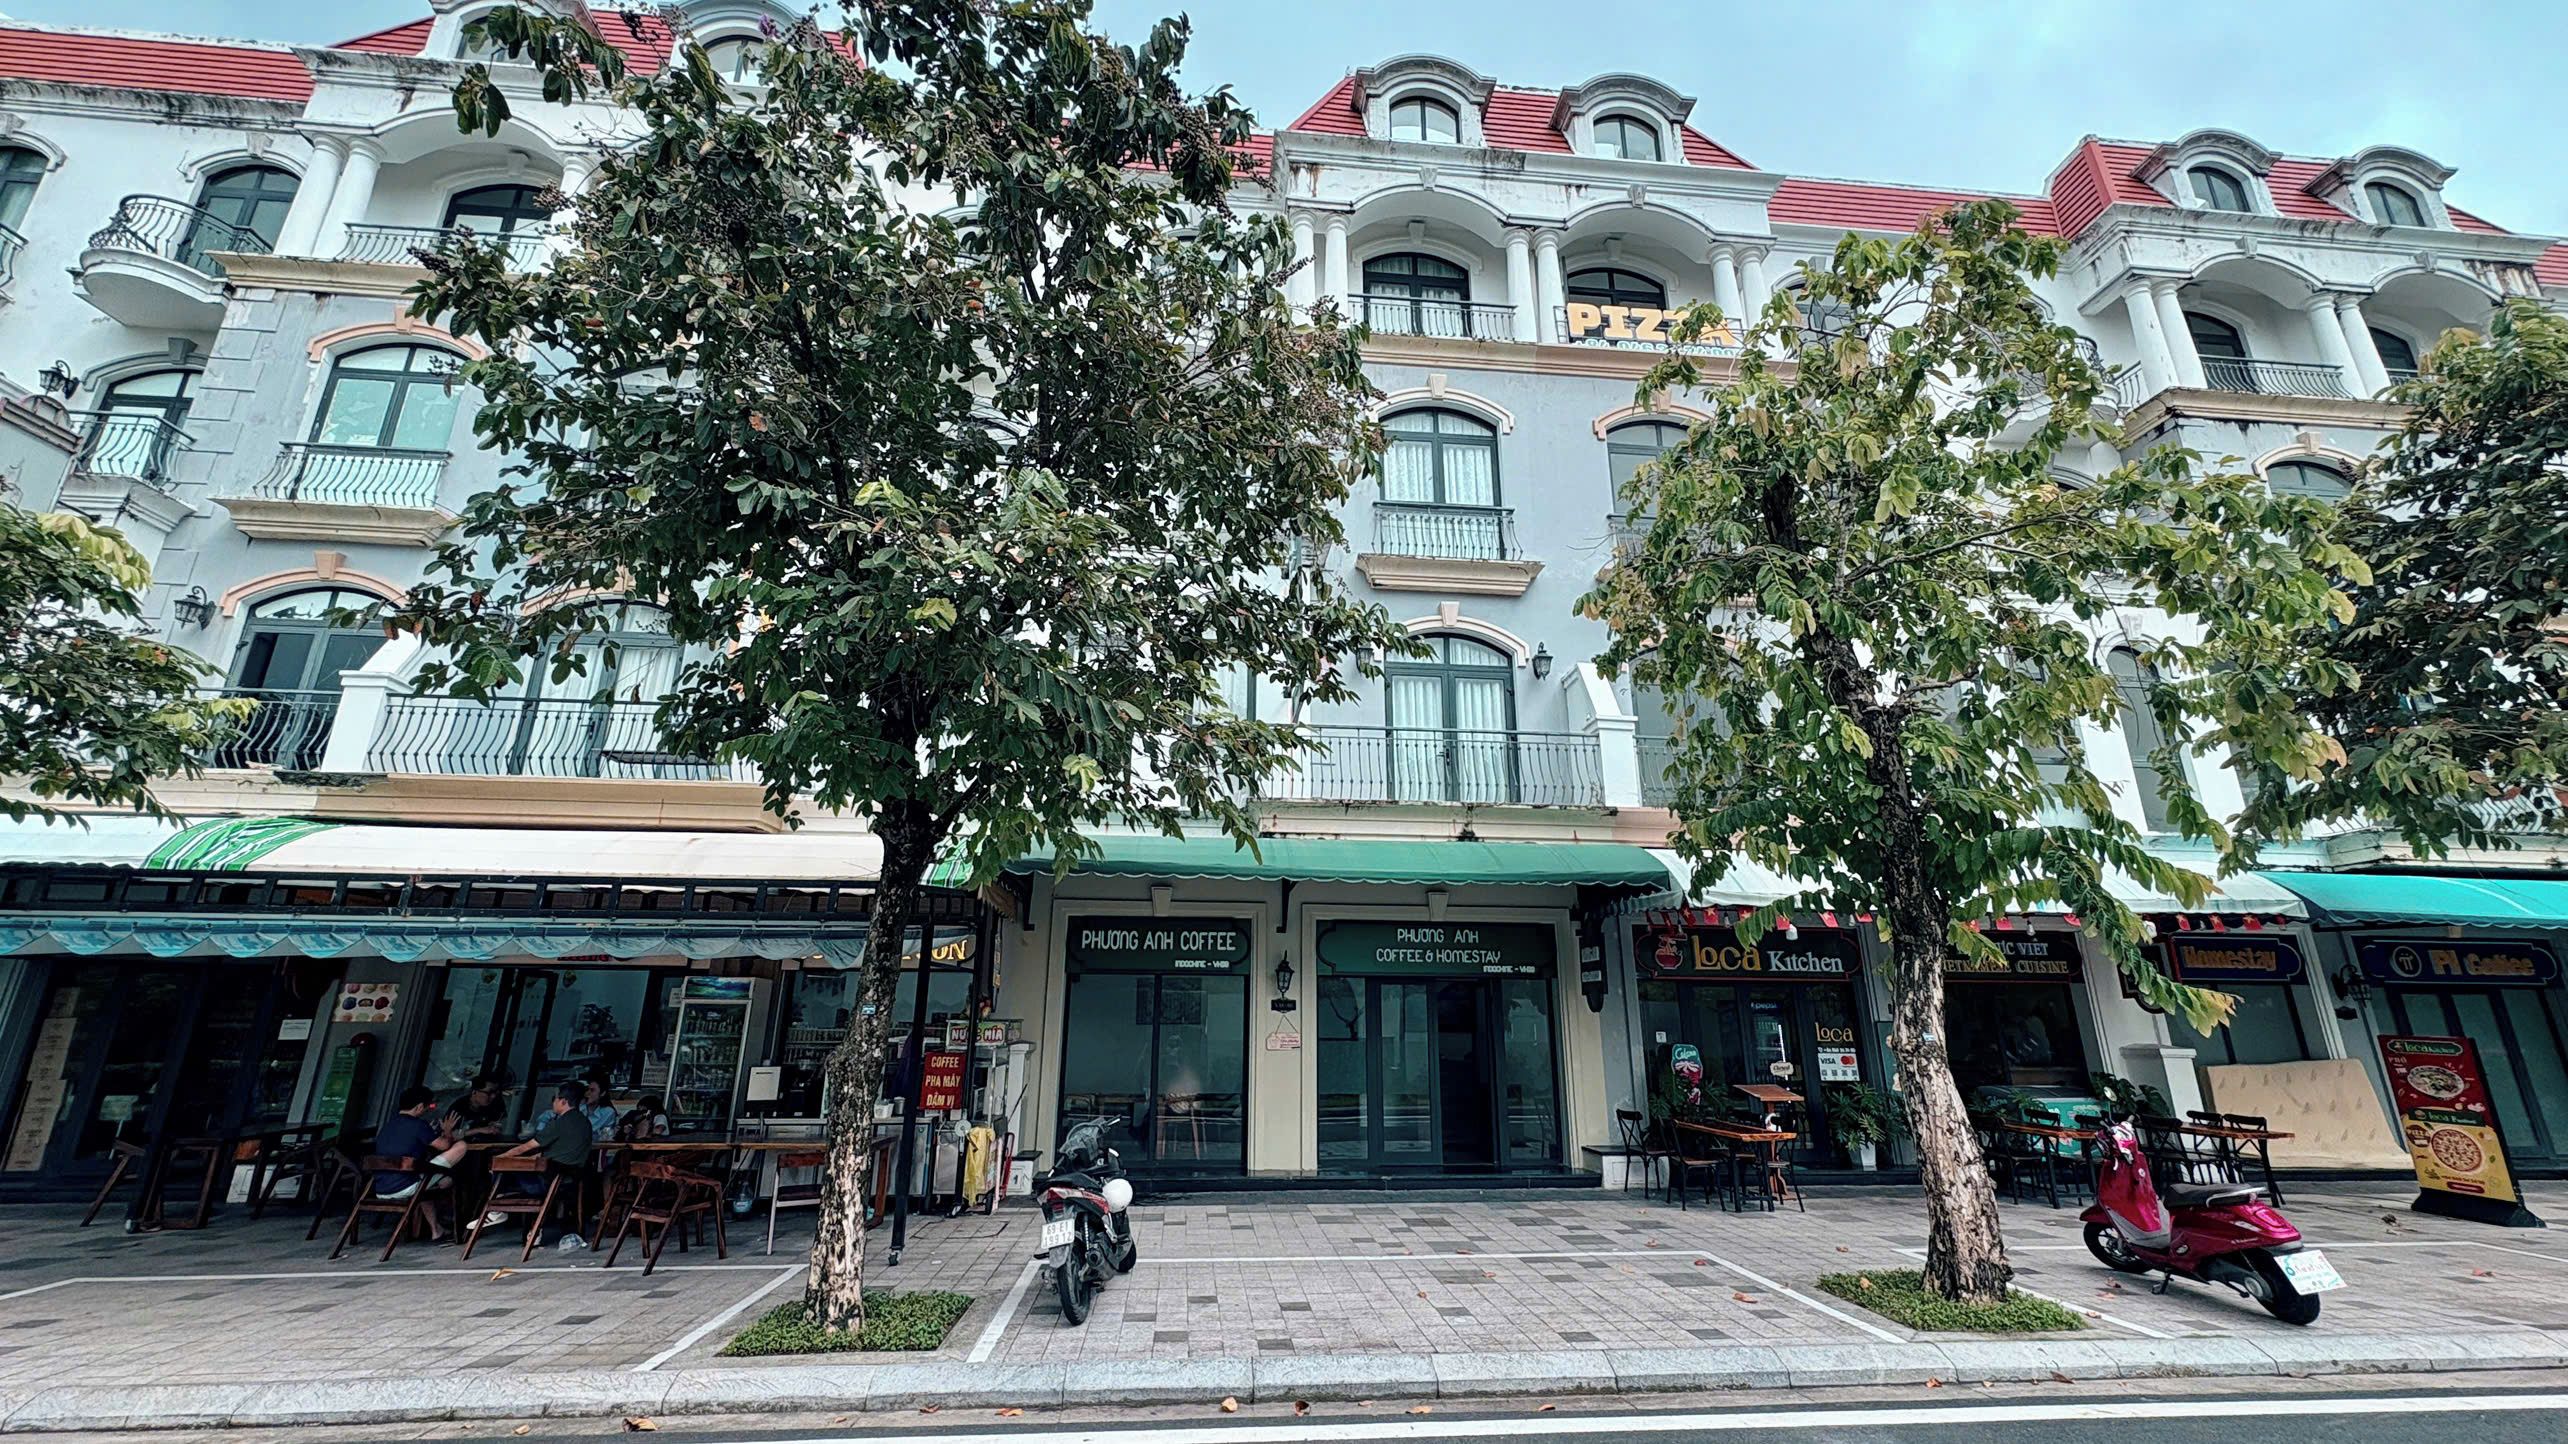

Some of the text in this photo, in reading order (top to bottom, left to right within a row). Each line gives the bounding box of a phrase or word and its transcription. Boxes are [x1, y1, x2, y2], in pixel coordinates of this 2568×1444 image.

[1180, 931, 1236, 950] COFFEE
[1376, 948, 1501, 964] COFFEE & HOMESTAY
[1767, 950, 1844, 972] Kitchen
[2184, 945, 2277, 971] Homestay
[2015, 960, 2069, 974] CUISINE
[931, 1056, 960, 1068] COFFEE
[925, 1075, 941, 1087] PHA
